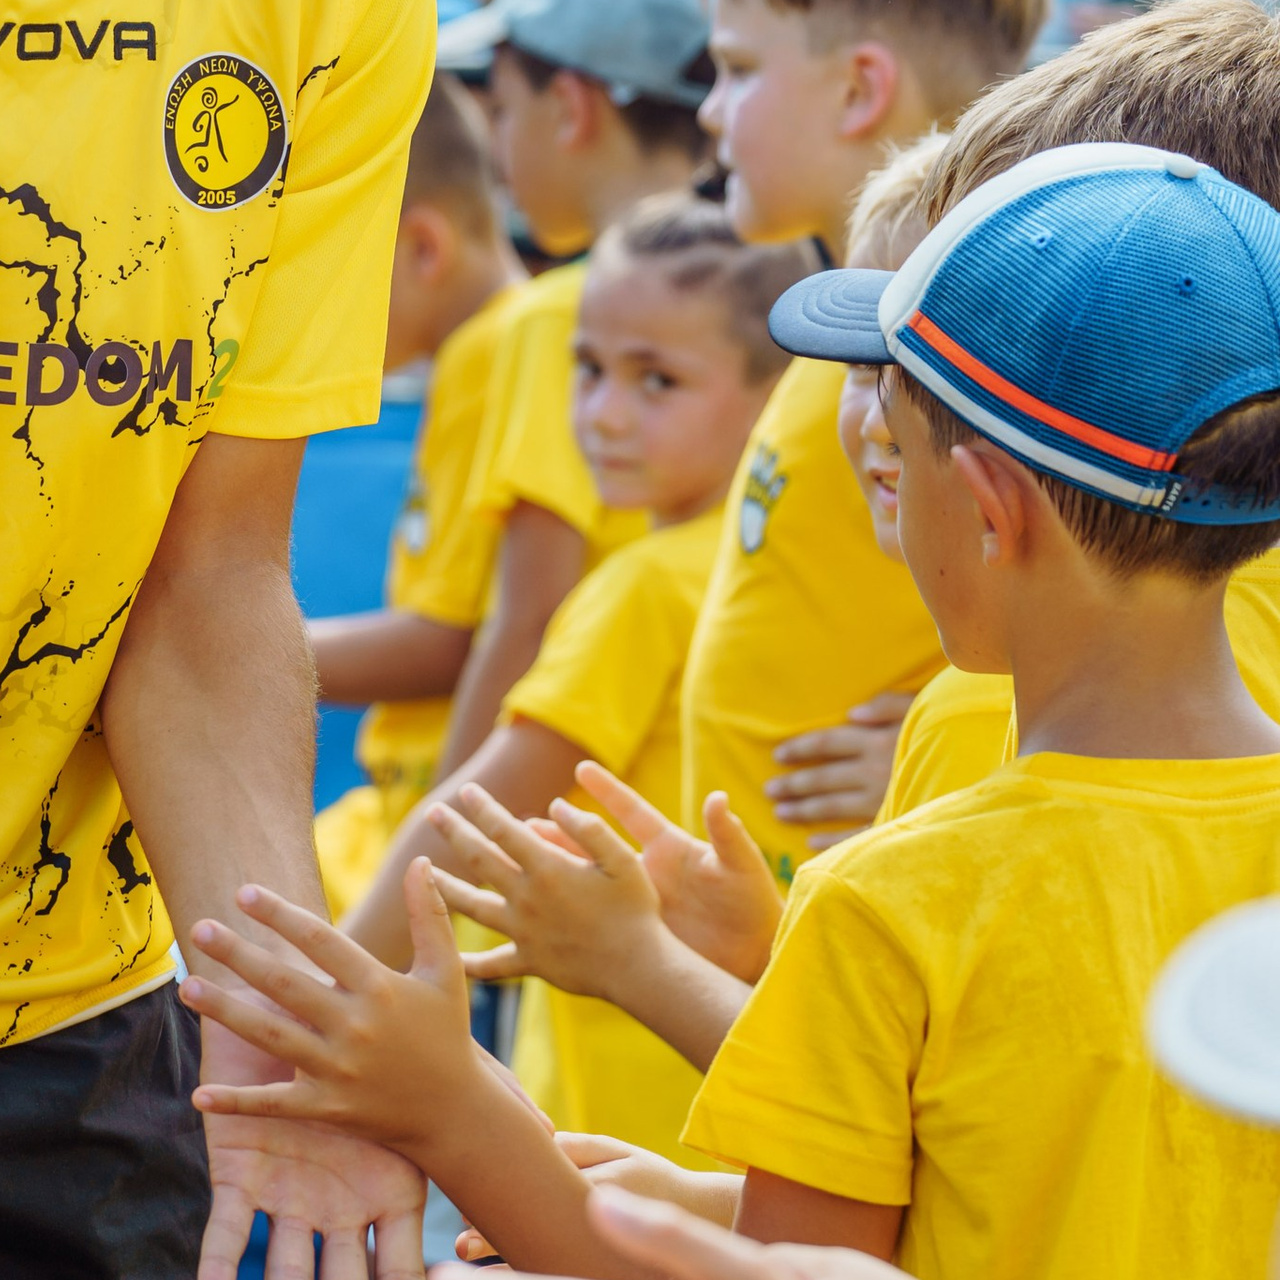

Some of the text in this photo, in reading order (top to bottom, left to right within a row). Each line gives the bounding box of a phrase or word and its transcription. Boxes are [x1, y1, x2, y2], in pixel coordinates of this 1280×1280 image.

[165, 72, 193, 130] ΕΝΩΣΗ
[199, 58, 239, 76] ΝΕΩΝ
[197, 190, 237, 205] 2005
